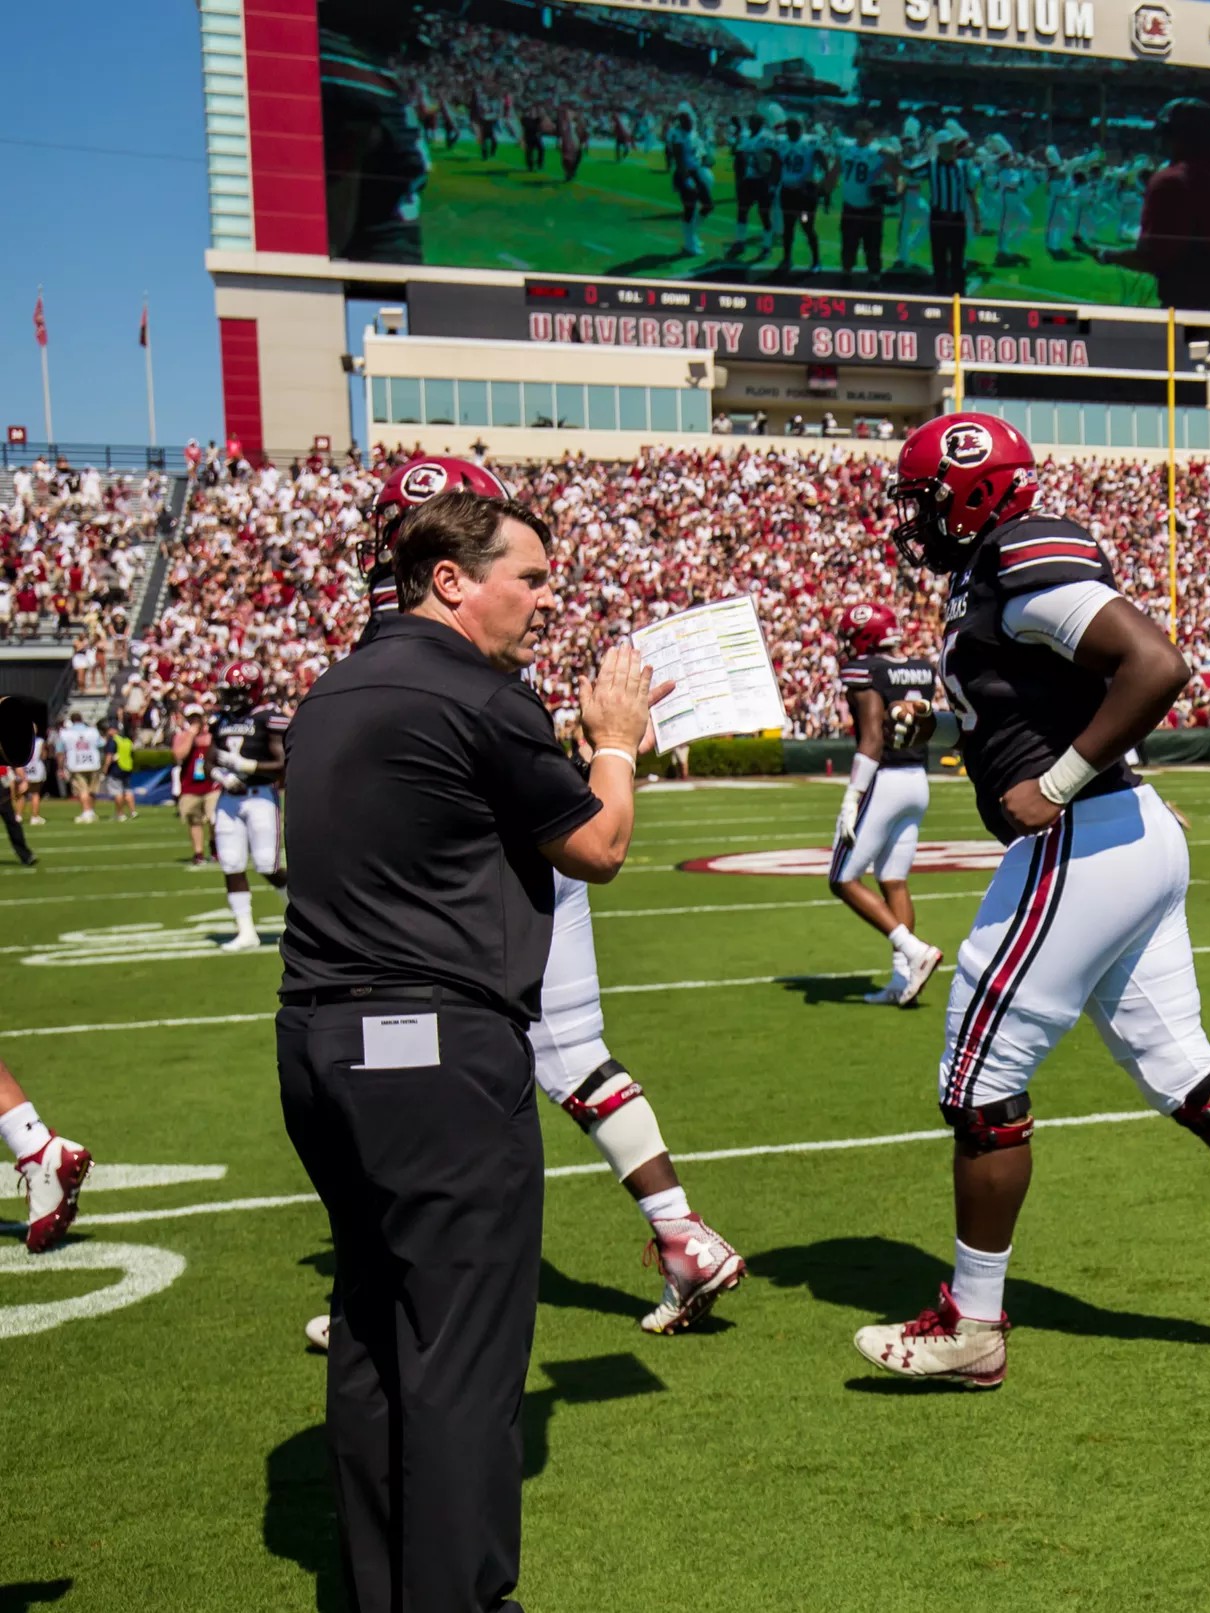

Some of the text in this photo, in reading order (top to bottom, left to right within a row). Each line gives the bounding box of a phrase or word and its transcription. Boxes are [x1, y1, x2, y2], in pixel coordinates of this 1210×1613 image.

[905, 0, 1094, 39] STADIUM
[800, 295, 846, 317] 2:54
[529, 312, 1090, 367] UNIVERSITY OF SOUTH CAROLINA
